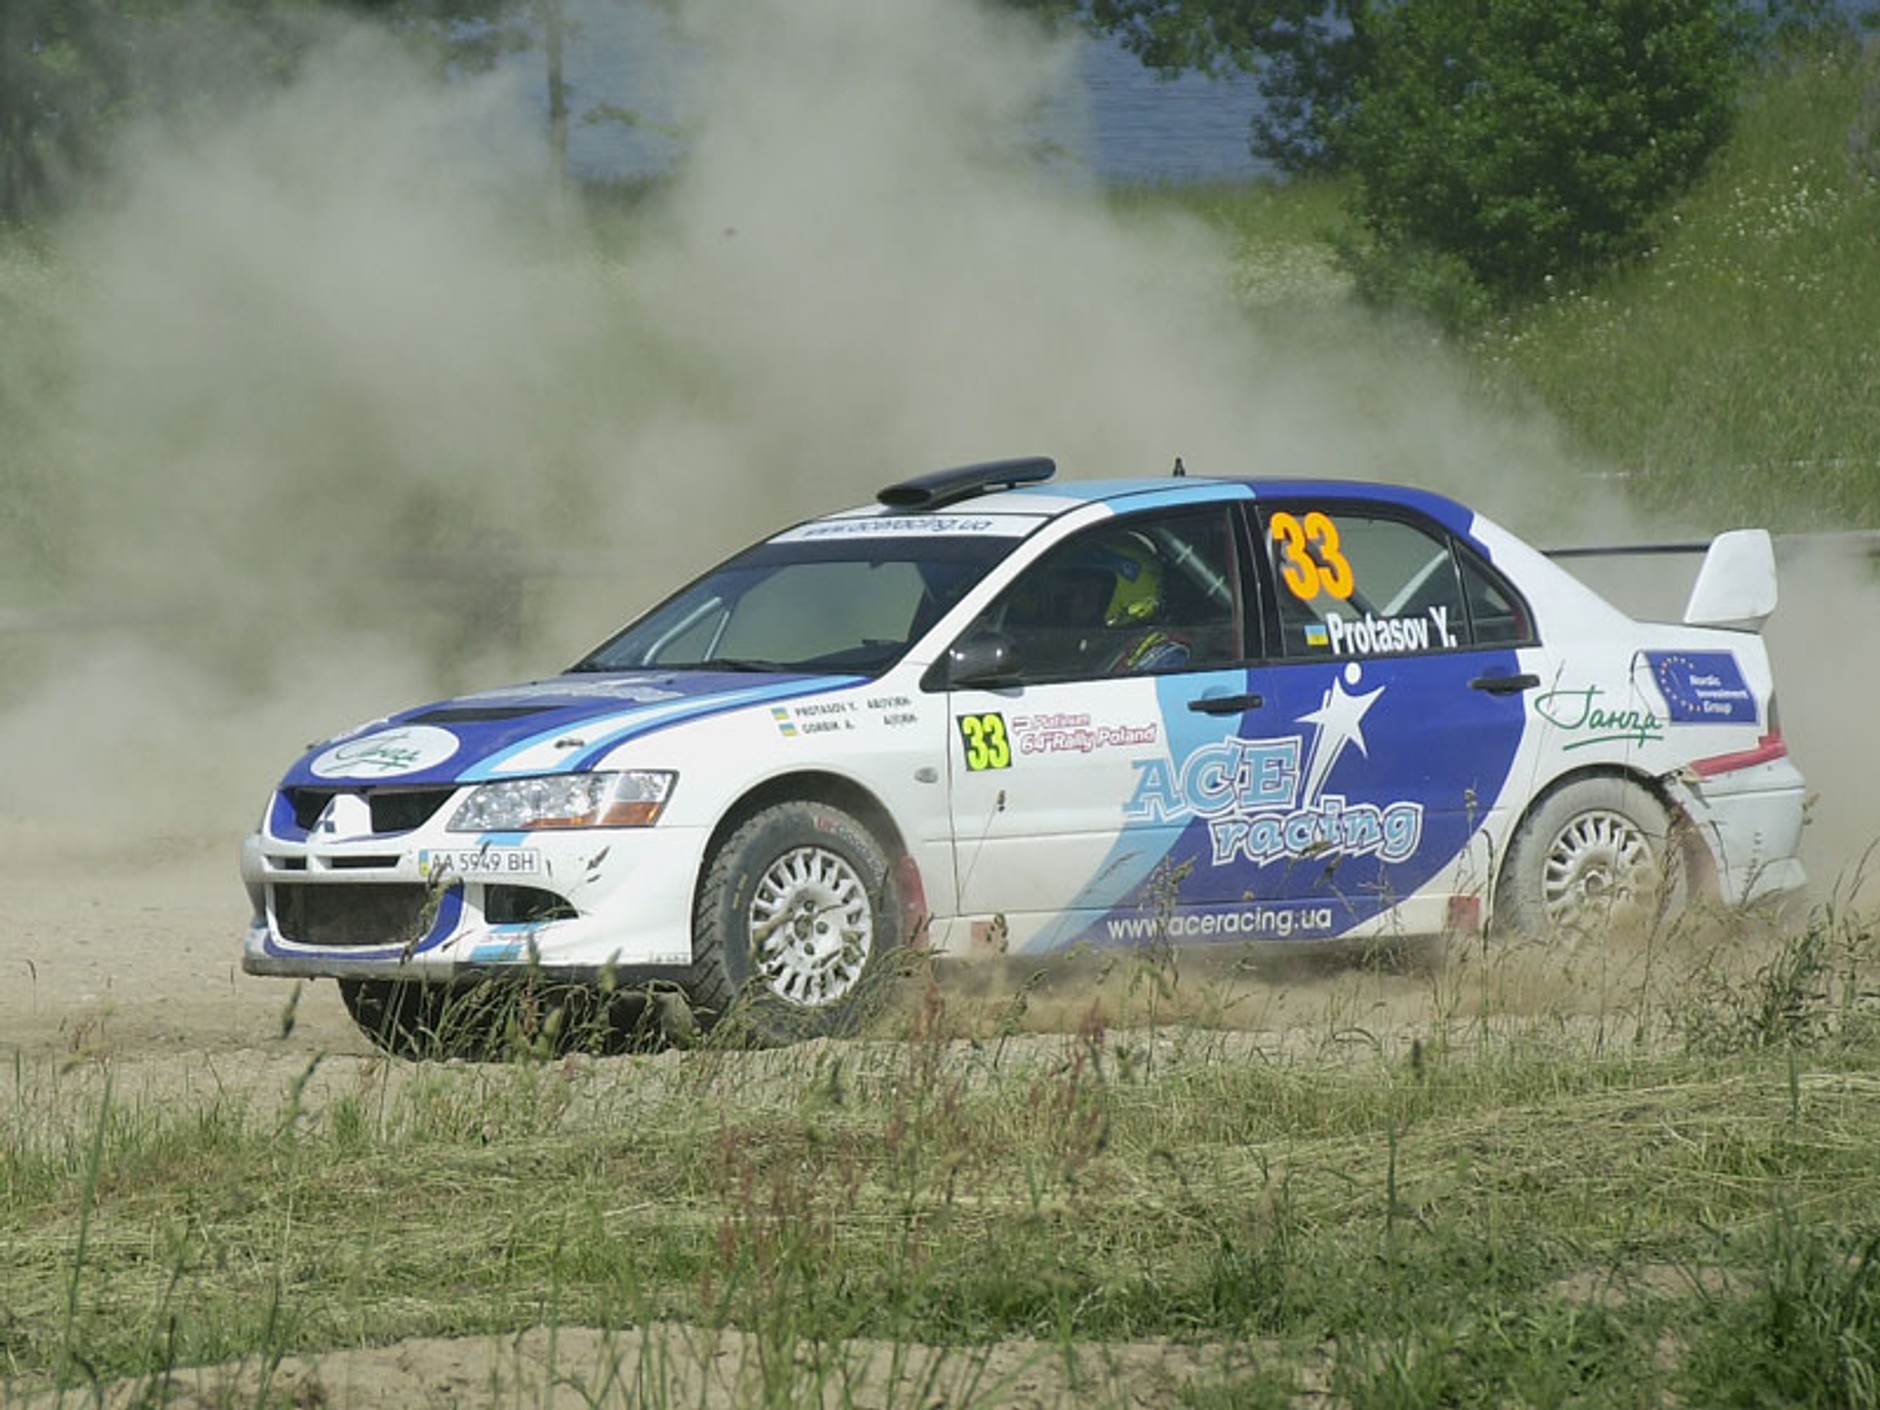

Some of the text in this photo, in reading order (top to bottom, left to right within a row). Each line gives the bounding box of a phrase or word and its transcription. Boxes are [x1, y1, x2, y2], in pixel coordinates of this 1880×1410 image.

[1270, 511, 1355, 600] 33
[1325, 606, 1457, 655] Protasov Y.
[962, 713, 1010, 770] 33
[1053, 729, 1094, 753] Rally
[1096, 723, 1157, 747] Poland
[1122, 736, 1302, 821] ACE
[1209, 796, 1424, 867] racing
[432, 853, 535, 871] AA 5949 BH
[1107, 907, 1332, 939] wwwaceracing.ua
